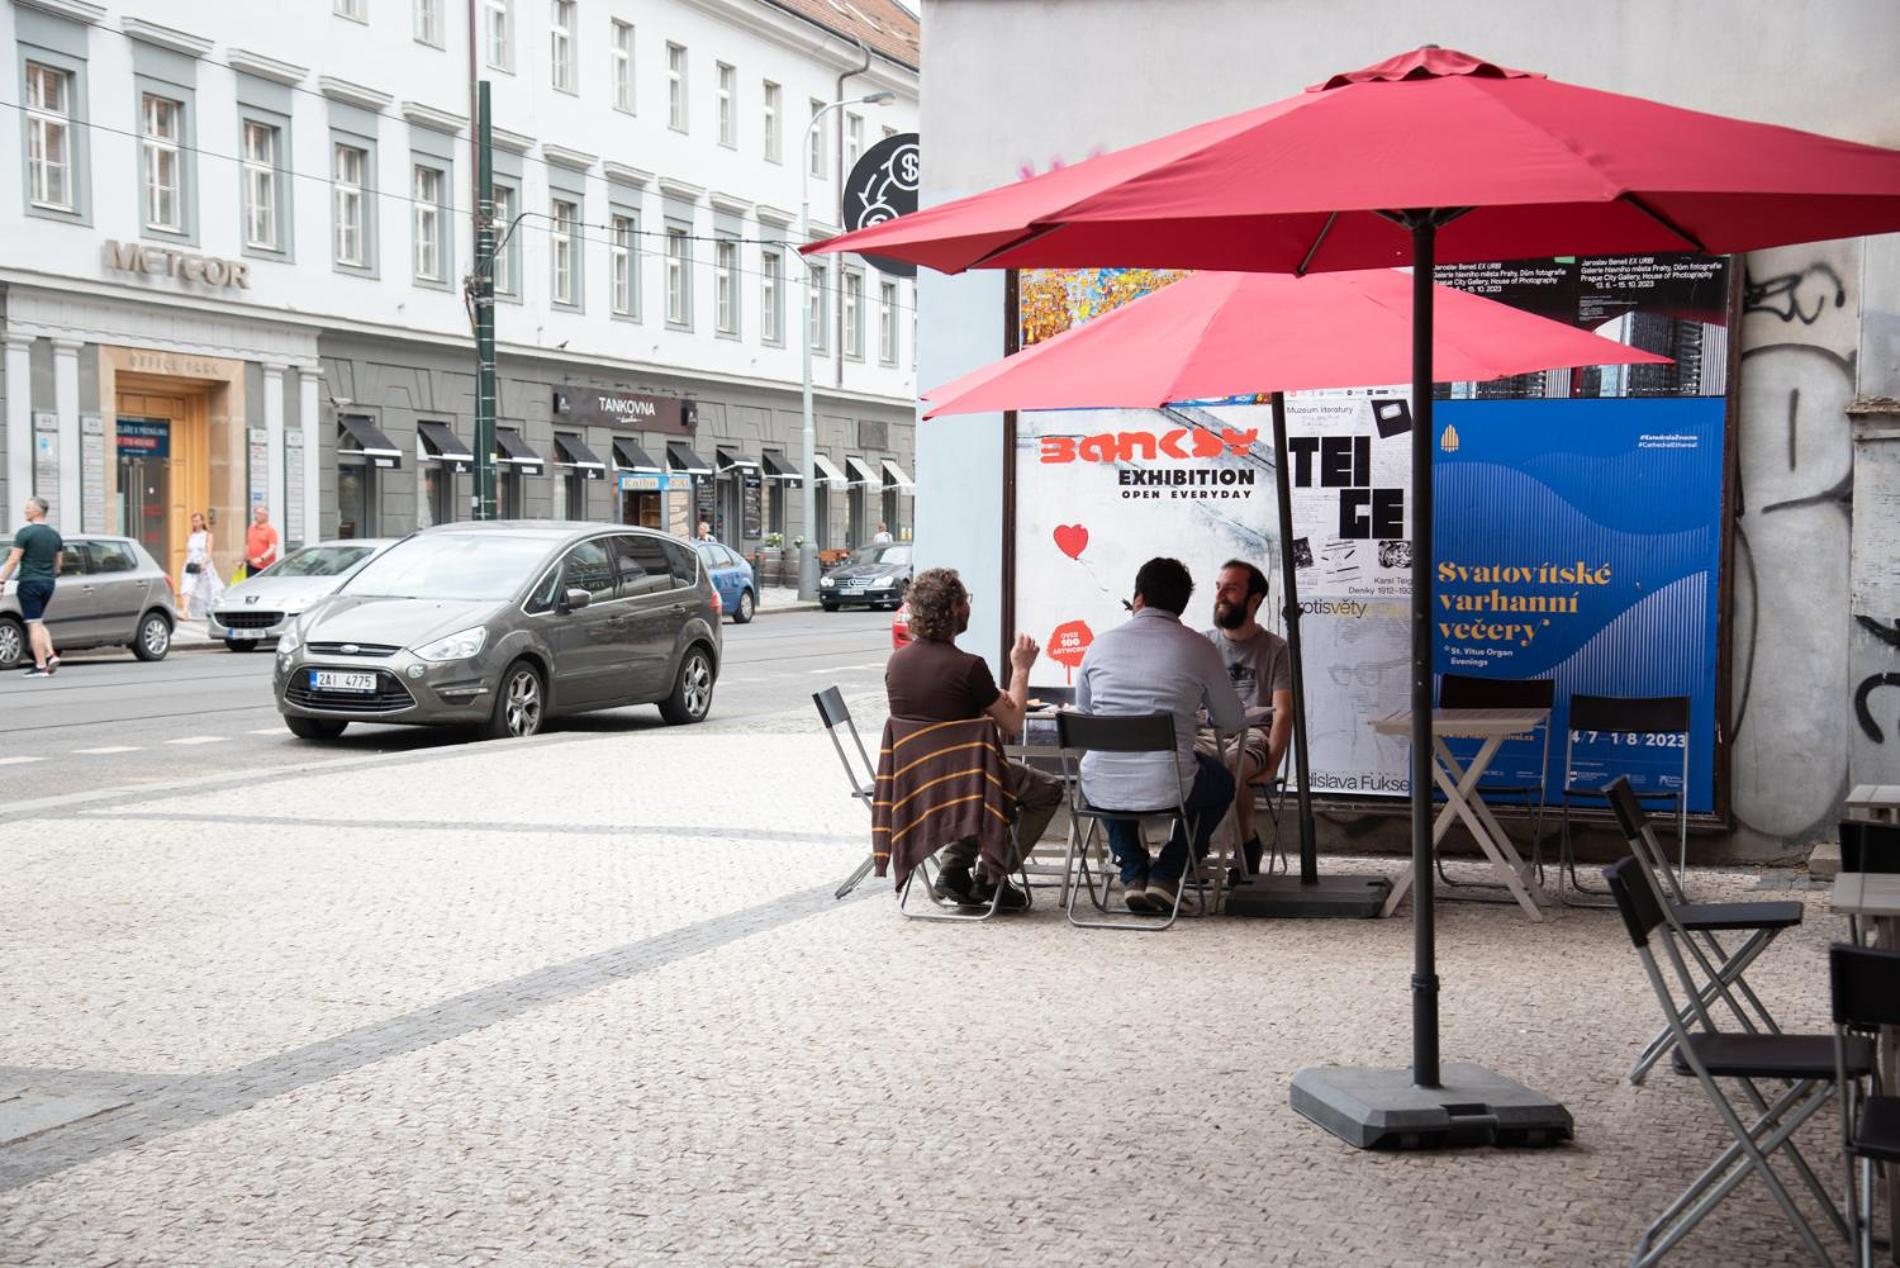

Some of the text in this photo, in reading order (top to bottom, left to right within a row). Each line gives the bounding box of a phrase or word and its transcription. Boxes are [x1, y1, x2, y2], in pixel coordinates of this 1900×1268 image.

[105, 239, 250, 289] METEOR
[598, 397, 656, 416] TANKOVNA
[1288, 436, 1371, 488] TEI
[1118, 469, 1255, 486] EXHIBITION
[1121, 490, 1252, 499] OPEN EVERYDAY
[1340, 488, 1404, 540] GE
[1438, 561, 1612, 585] Svatovítské
[1297, 598, 1367, 619] rotisvěty
[1439, 588, 1579, 613] varhanní
[1061, 639, 1080, 647] 100
[1486, 648, 1513, 658] Organ
[1450, 657, 1488, 668] Evenings
[345, 674, 371, 688] 4775
[1308, 772, 1358, 790] dislava
